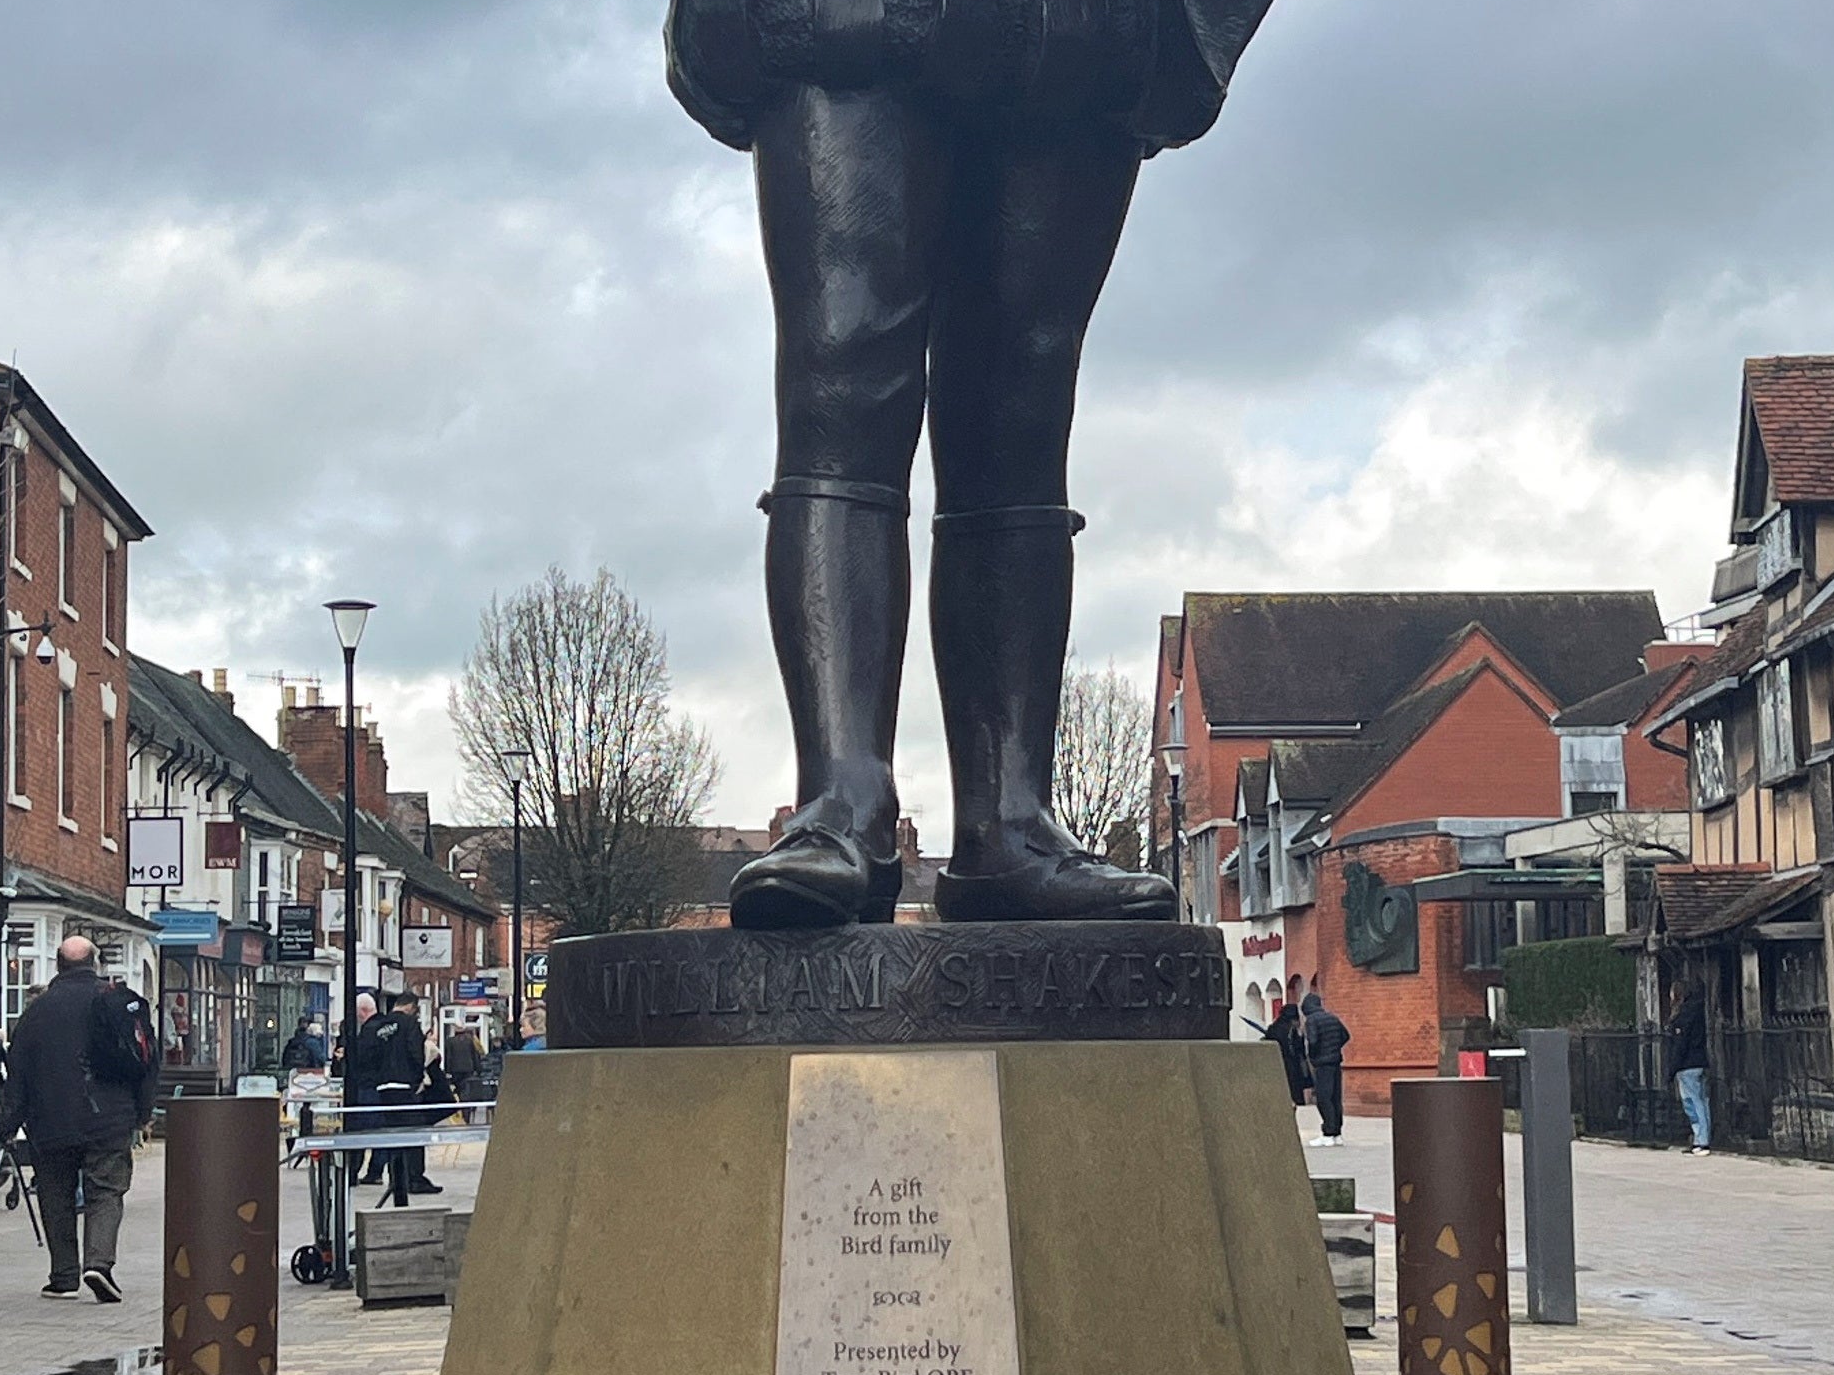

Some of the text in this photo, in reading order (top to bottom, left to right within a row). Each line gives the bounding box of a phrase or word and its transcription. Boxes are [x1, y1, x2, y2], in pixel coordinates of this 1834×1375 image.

[131, 865, 178, 879] MOR
[602, 951, 1231, 1017] WILLIAM SHAKESPE
[869, 1178, 923, 1202] A gift
[854, 1204, 939, 1225] from the
[841, 1233, 952, 1259] Bird family
[834, 1339, 961, 1365] Presented by
